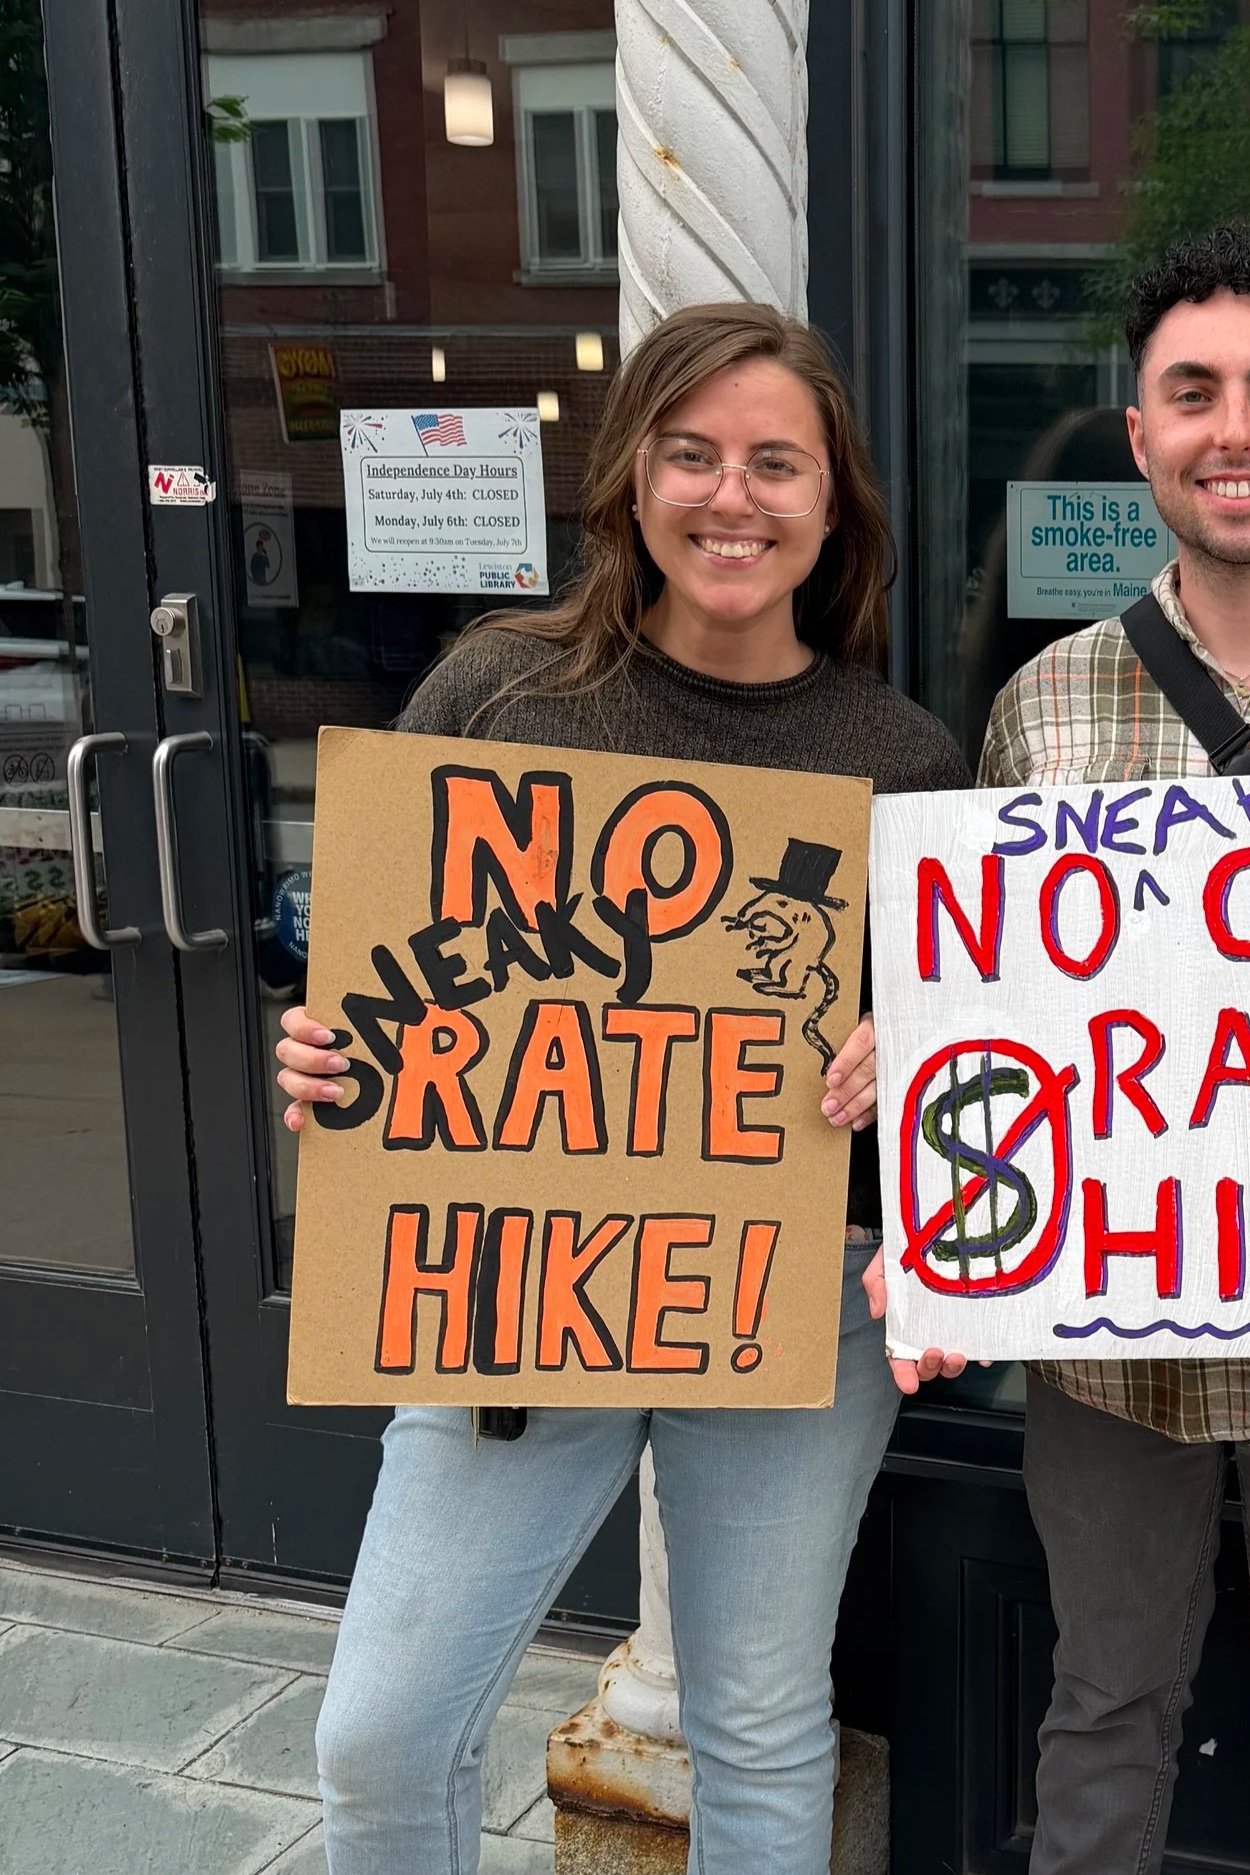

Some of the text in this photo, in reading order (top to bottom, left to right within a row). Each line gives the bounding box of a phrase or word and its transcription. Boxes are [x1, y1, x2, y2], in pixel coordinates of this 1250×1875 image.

[366, 464, 518, 480] Independence Day Hours
[173, 487, 200, 496] NORRIS
[368, 489, 519, 503] Saturday, July 4th: CLOSED
[1047, 495, 1140, 522] This is a
[374, 515, 521, 530] Monday, July 6th: CLOSED
[370, 537, 382, 545] We
[382, 536, 395, 545] will
[396, 538, 419, 547] reopen
[465, 538, 495, 548] Tuesday,
[496, 538, 510, 548] July
[511, 538, 522, 547] 7th
[1031, 521, 1157, 548] smoke-free
[479, 561, 513, 571] Lewiston
[1066, 552, 1120, 573] area.
[480, 571, 510, 580] PUBLIC
[480, 581, 516, 589] LIBRARY
[1037, 586, 1063, 597] Breathe
[1083, 587, 1103, 598] you're
[1105, 588, 1111, 597] in
[1113, 583, 1147, 598] Maine
[431, 766, 733, 943] NO
[917, 852, 1120, 982] NO
[308, 888, 653, 1130] SNEAKY
[382, 1000, 785, 1164] RATE
[374, 1203, 782, 1373] HIKE!
